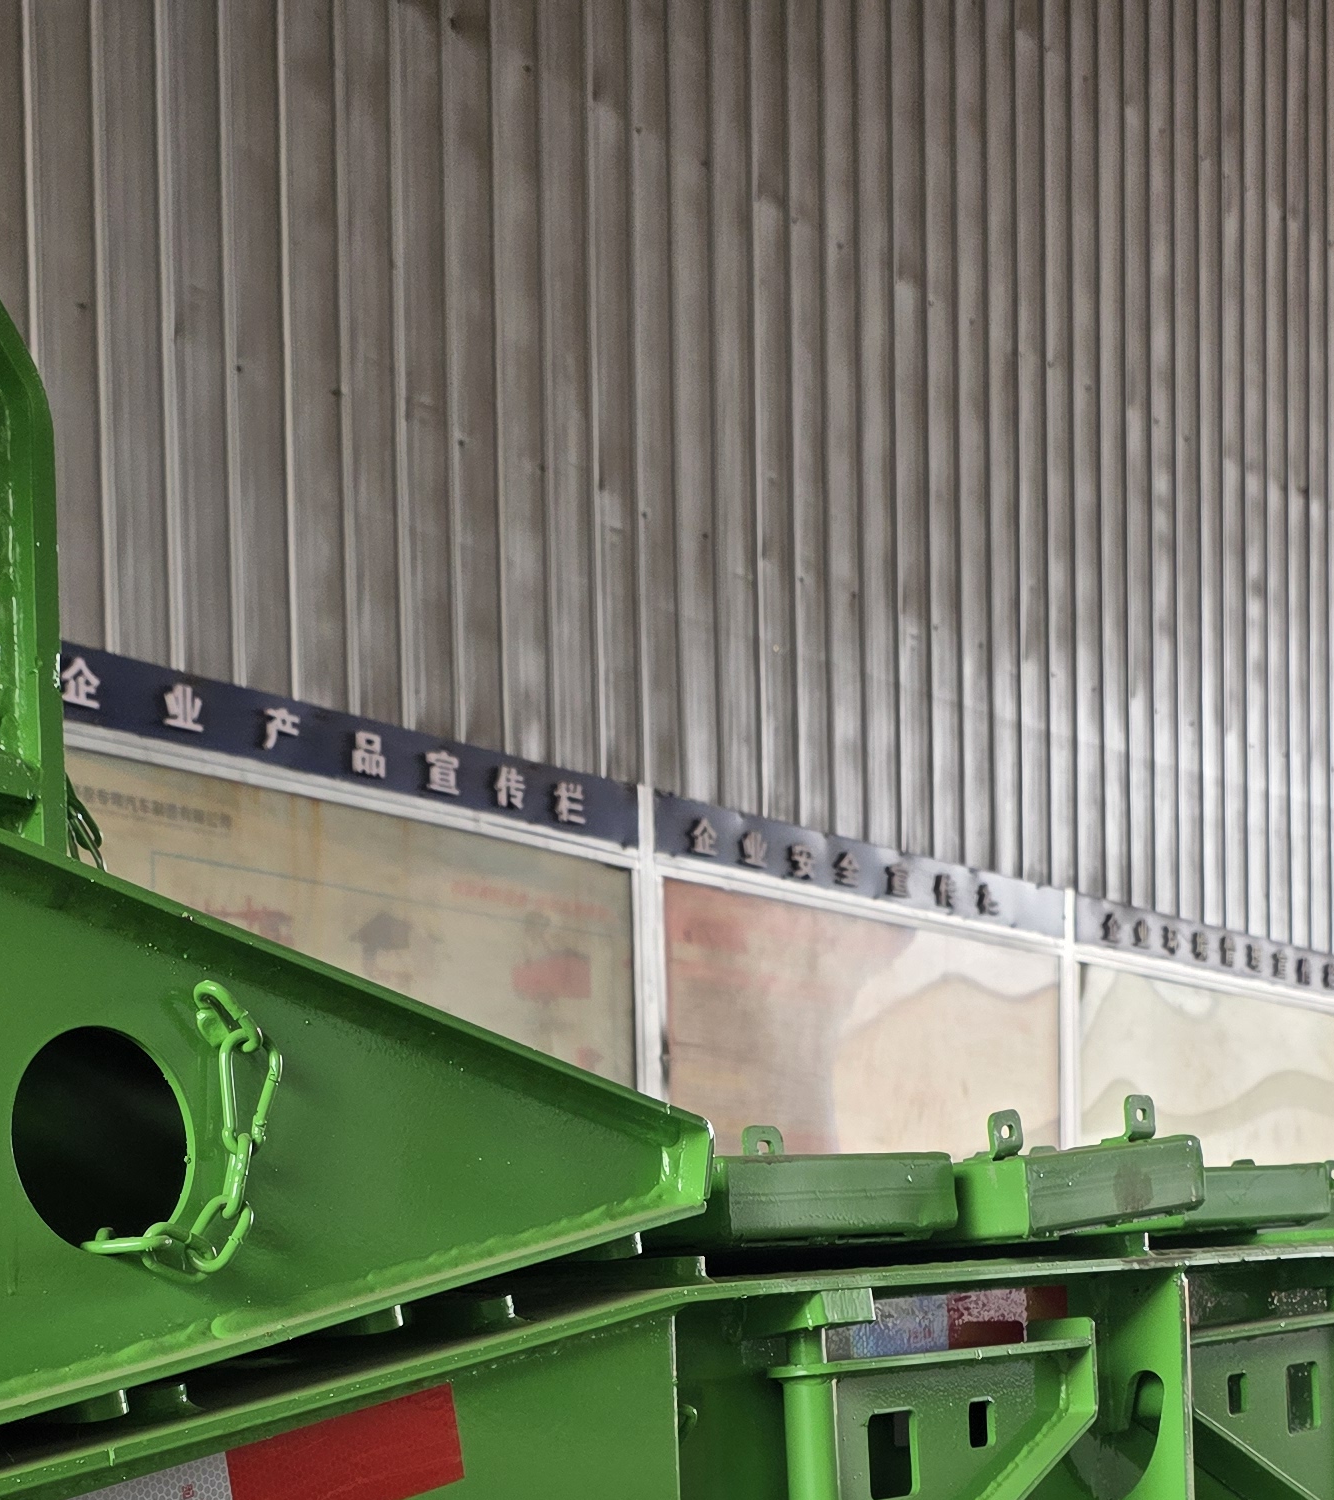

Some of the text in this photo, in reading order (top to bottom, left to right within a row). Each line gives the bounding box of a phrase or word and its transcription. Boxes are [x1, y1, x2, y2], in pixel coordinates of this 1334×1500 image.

[61, 657, 587, 826] 企业产品宣传栏
